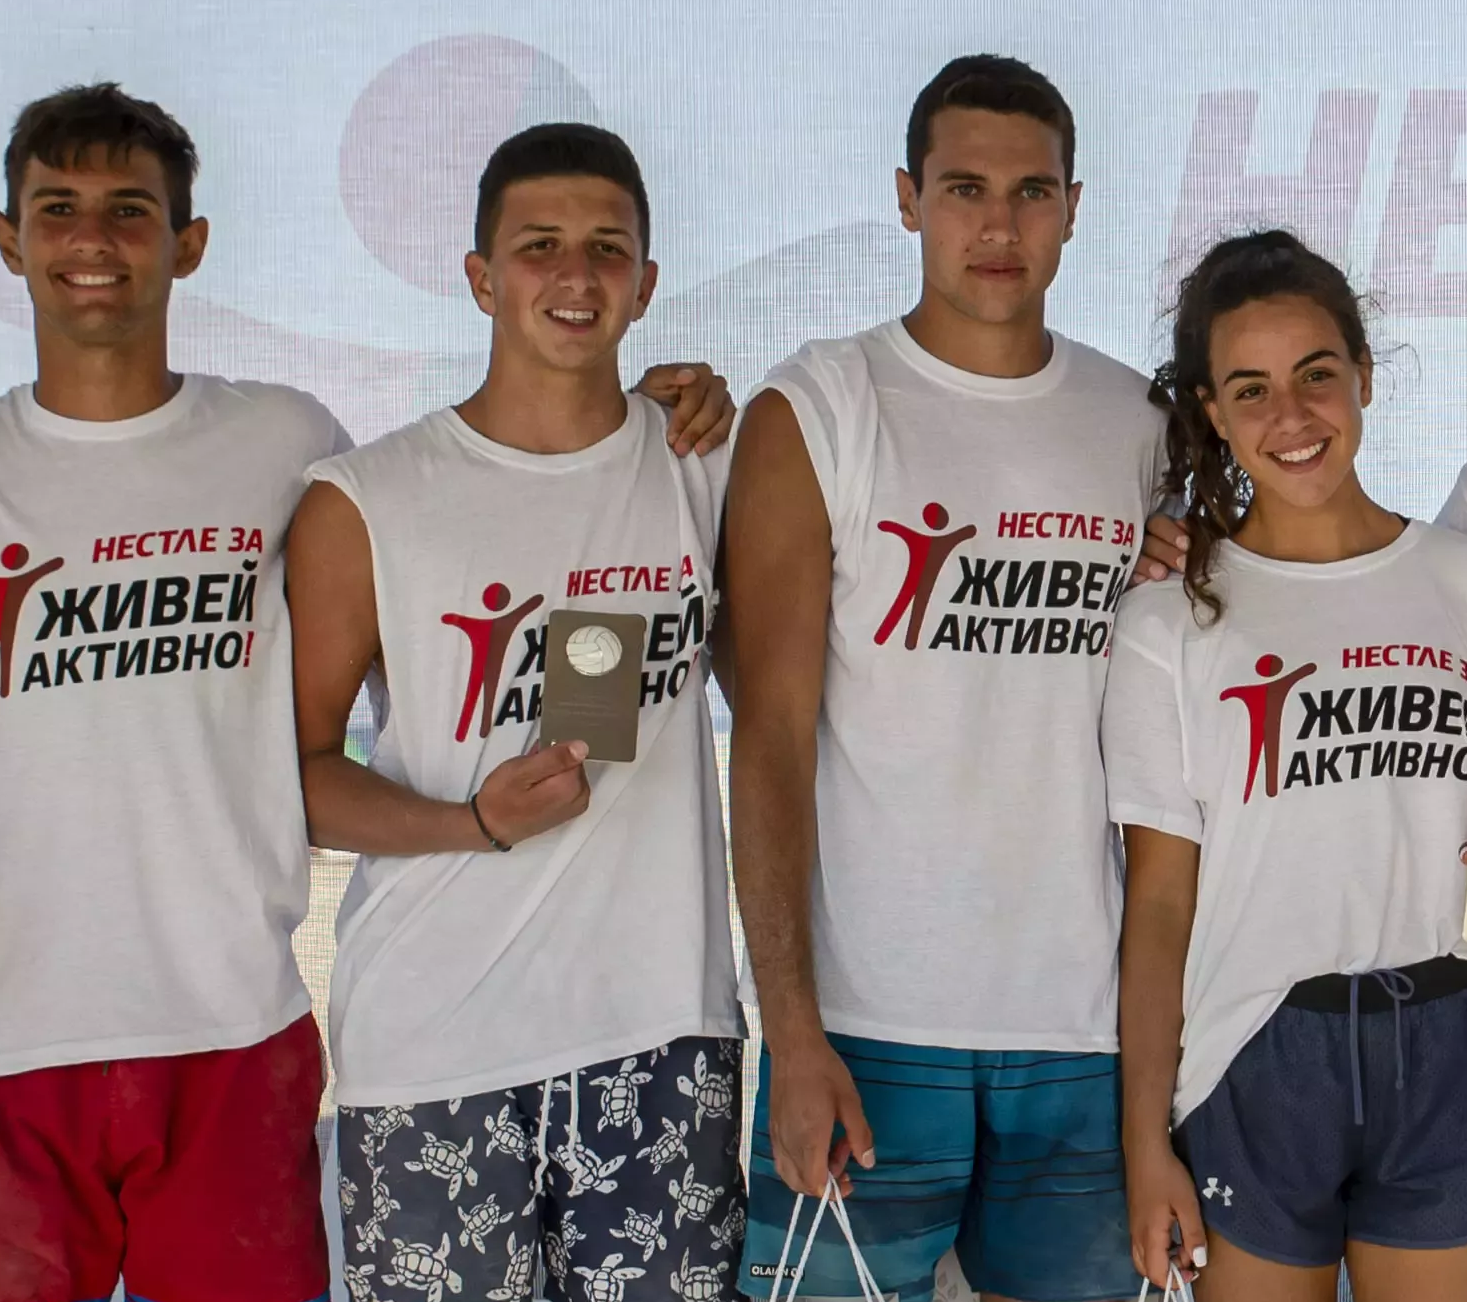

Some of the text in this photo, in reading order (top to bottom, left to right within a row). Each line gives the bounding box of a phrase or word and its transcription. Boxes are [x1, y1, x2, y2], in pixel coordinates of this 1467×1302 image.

[92, 526, 264, 564] НЕСТЛЕ ЗА
[997, 511, 1135, 548] НЕСТЛЕ ЗА
[34, 558, 259, 643] ЖИВЕЙ
[566, 565, 672, 598] НЕСТЛЕ
[949, 552, 1132, 614] ЖИВЕЙ
[20, 630, 255, 693] АКТИВНО!
[1341, 643, 1454, 673] НЕСТЛЕ
